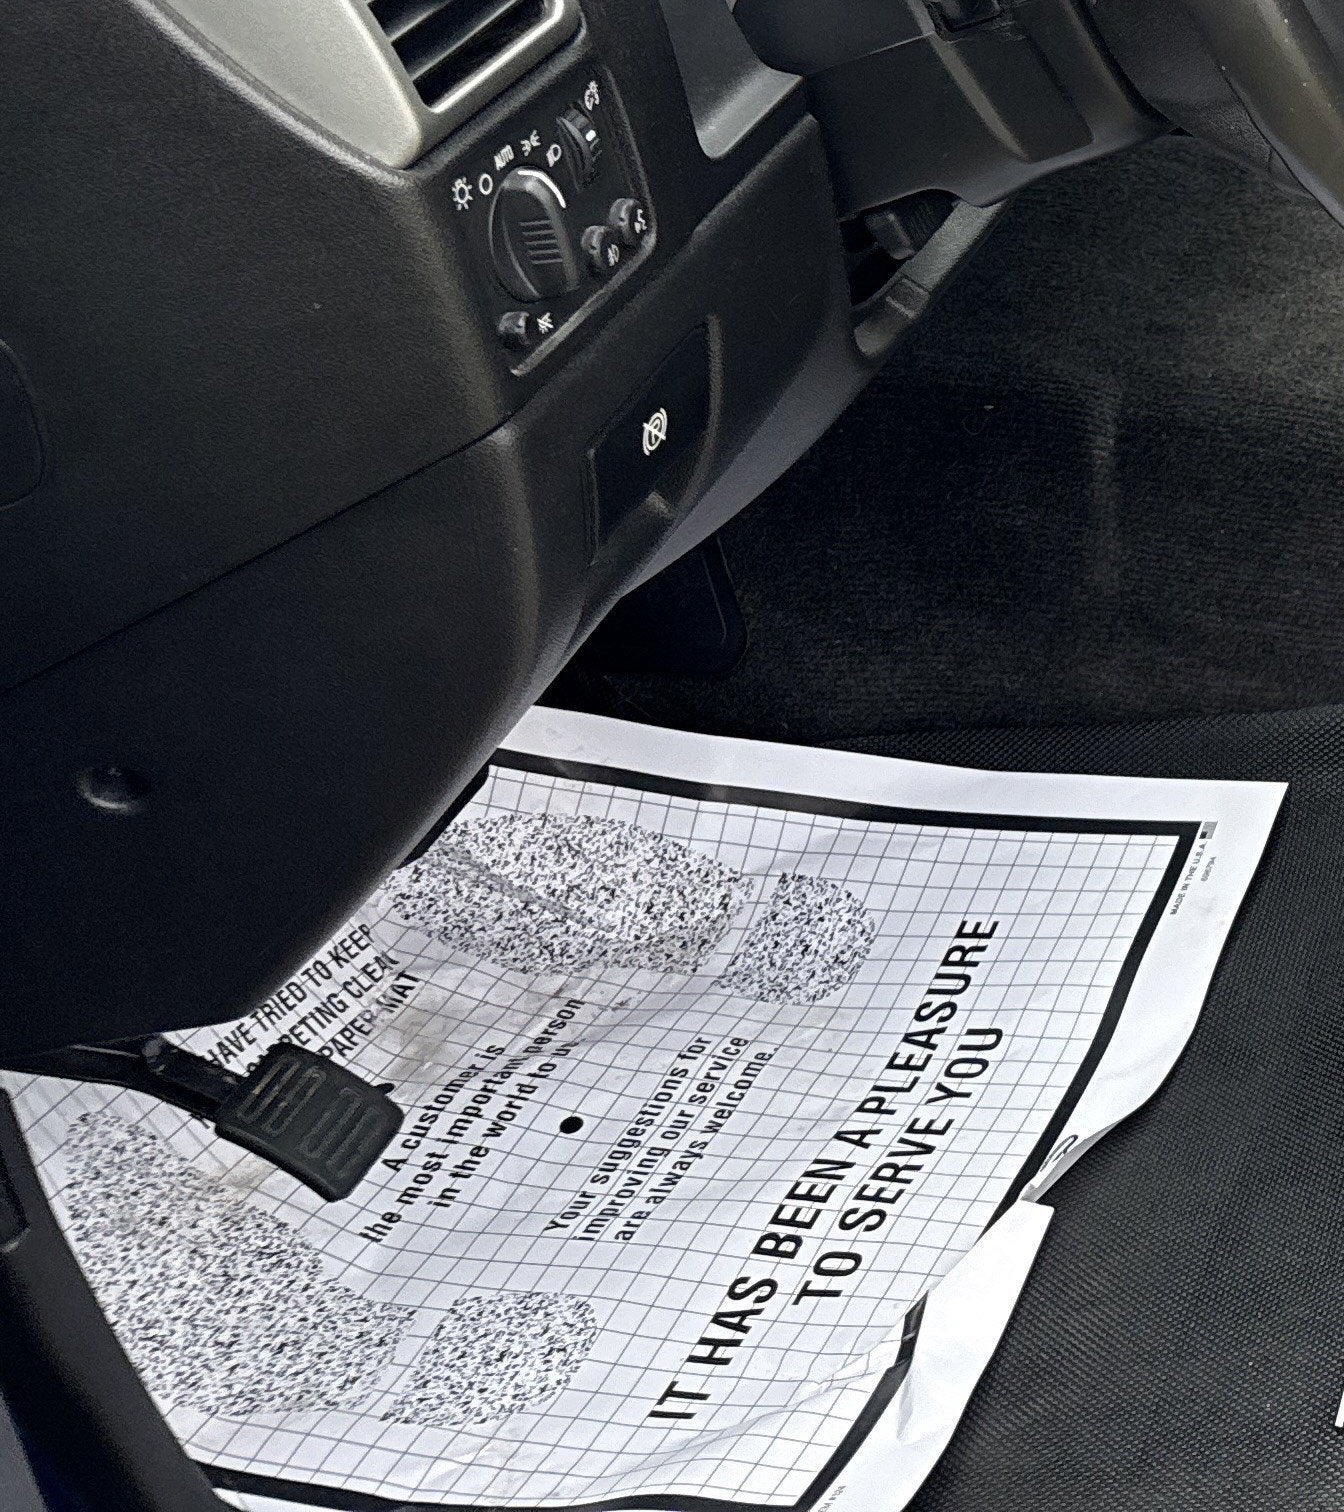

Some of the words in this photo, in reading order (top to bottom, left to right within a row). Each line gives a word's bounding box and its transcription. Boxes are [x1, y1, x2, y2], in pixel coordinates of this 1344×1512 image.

[249, 981, 307, 1032] TRIED
[301, 960, 332, 987] TO
[327, 924, 374, 969] KEEP
[853, 918, 1001, 1119] PLEASURE
[358, 1211, 402, 1243] the
[395, 1151, 449, 1206] most
[522, 998, 585, 1054] person
[381, 1158, 408, 1172] A
[400, 1063, 485, 1150] customer
[474, 1044, 506, 1060] is
[427, 1187, 462, 1208] in
[448, 1145, 491, 1179] the
[482, 1082, 538, 1138] world
[526, 1062, 557, 1079] to
[542, 1190, 597, 1233] Your
[590, 1066, 689, 1185] suggestions
[677, 1035, 713, 1062] for
[573, 1144, 672, 1242] improving
[660, 1109, 697, 1140] our
[688, 1036, 750, 1105] service
[613, 1209, 651, 1242] are
[644, 1139, 710, 1206] always
[703, 1046, 780, 1135] welcome.
[792, 1250, 863, 1307] TO
[837, 1116, 957, 1234] SERVE
[925, 1026, 1005, 1108] YOU
[833, 1125, 884, 1151] A
[750, 1158, 857, 1261] BEEN
[684, 1274, 779, 1366] HAS
[647, 1380, 713, 1421] IT
